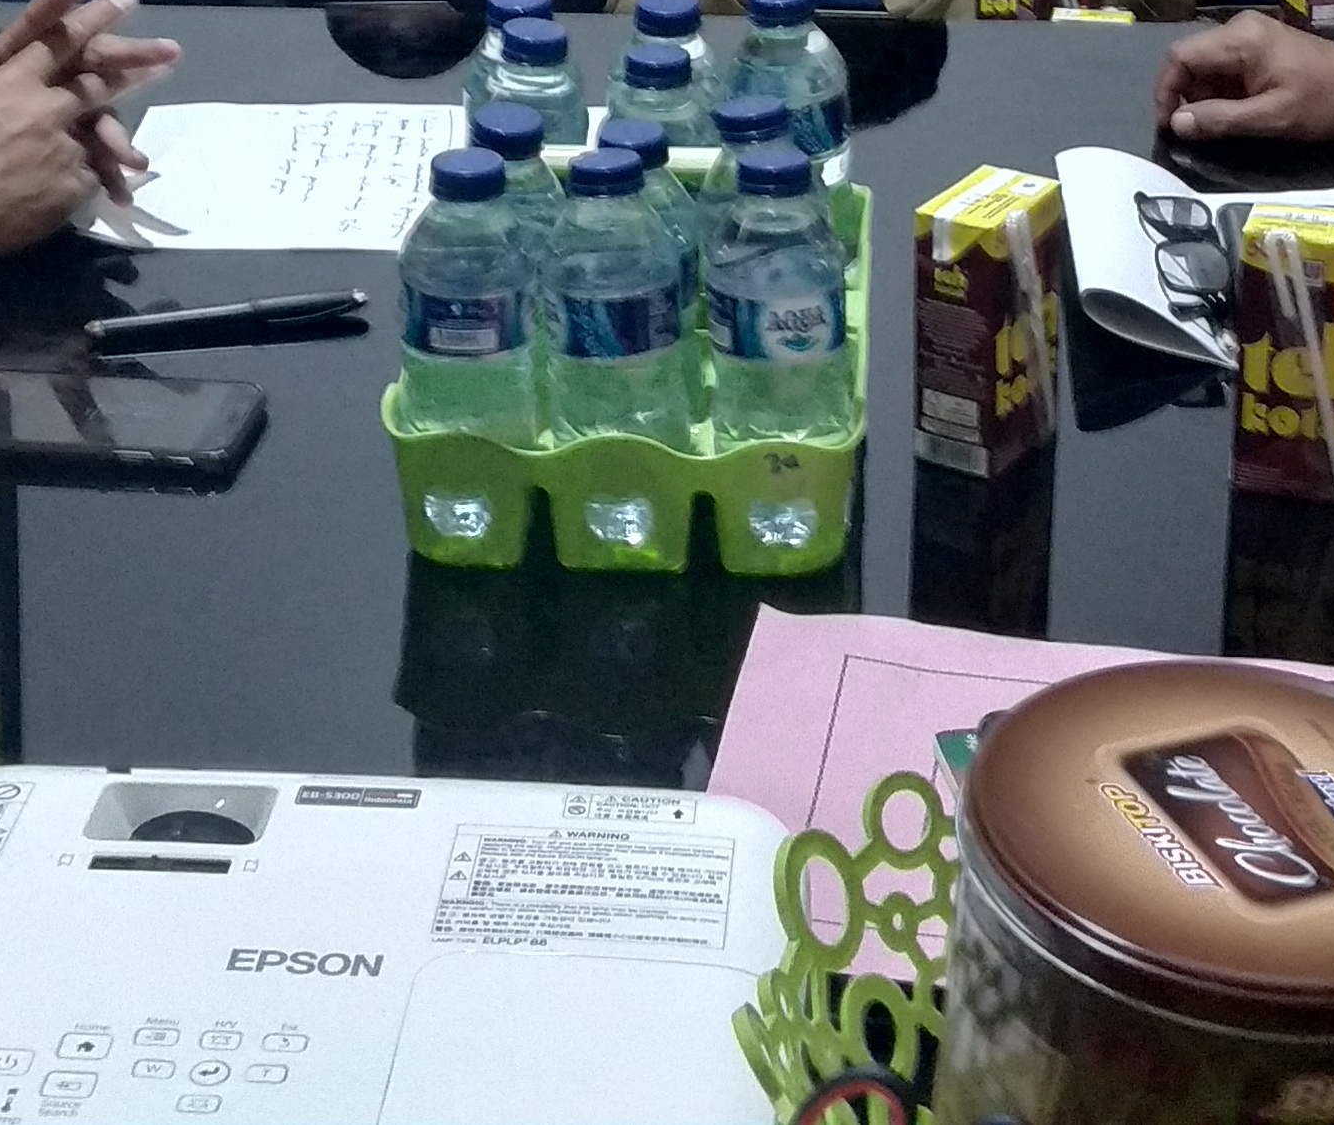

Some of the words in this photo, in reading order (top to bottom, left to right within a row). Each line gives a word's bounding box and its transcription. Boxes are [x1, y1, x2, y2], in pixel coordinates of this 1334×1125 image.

[767, 305, 826, 333] AQUA
[621, 795, 681, 806] CAUTION
[566, 830, 631, 842] WARNING
[1099, 783, 1224, 890] BISKITOP
[225, 948, 385, 977] EPSON
